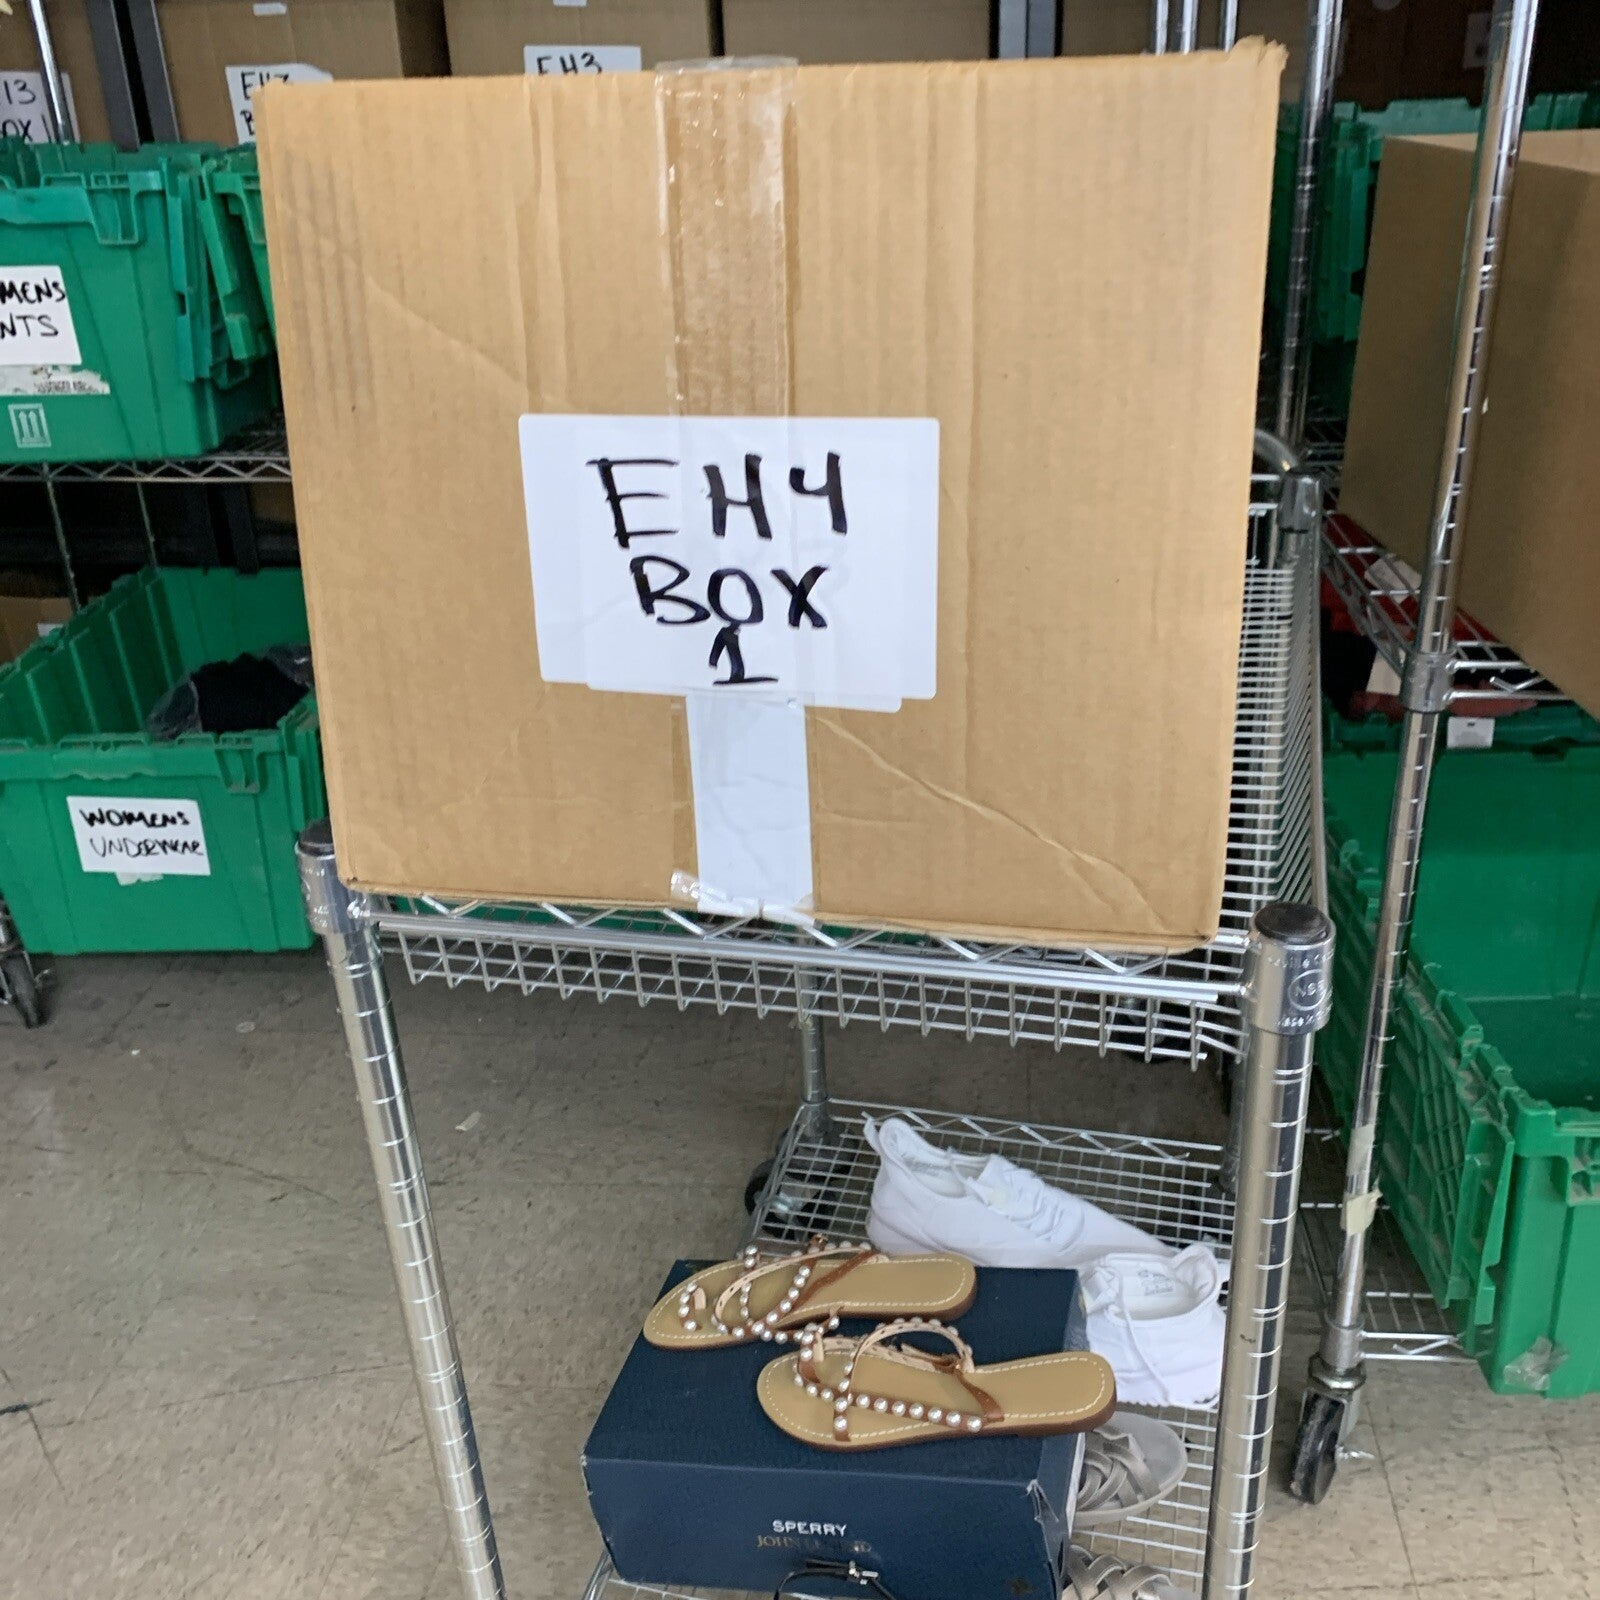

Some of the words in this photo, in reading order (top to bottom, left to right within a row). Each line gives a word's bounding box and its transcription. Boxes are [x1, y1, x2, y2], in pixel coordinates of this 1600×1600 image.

[0, 118, 33, 142] OX
[585, 451, 848, 549] EH4
[629, 555, 830, 629] BOX
[709, 623, 779, 685] 1
[772, 1519, 847, 1537] SPERRY
